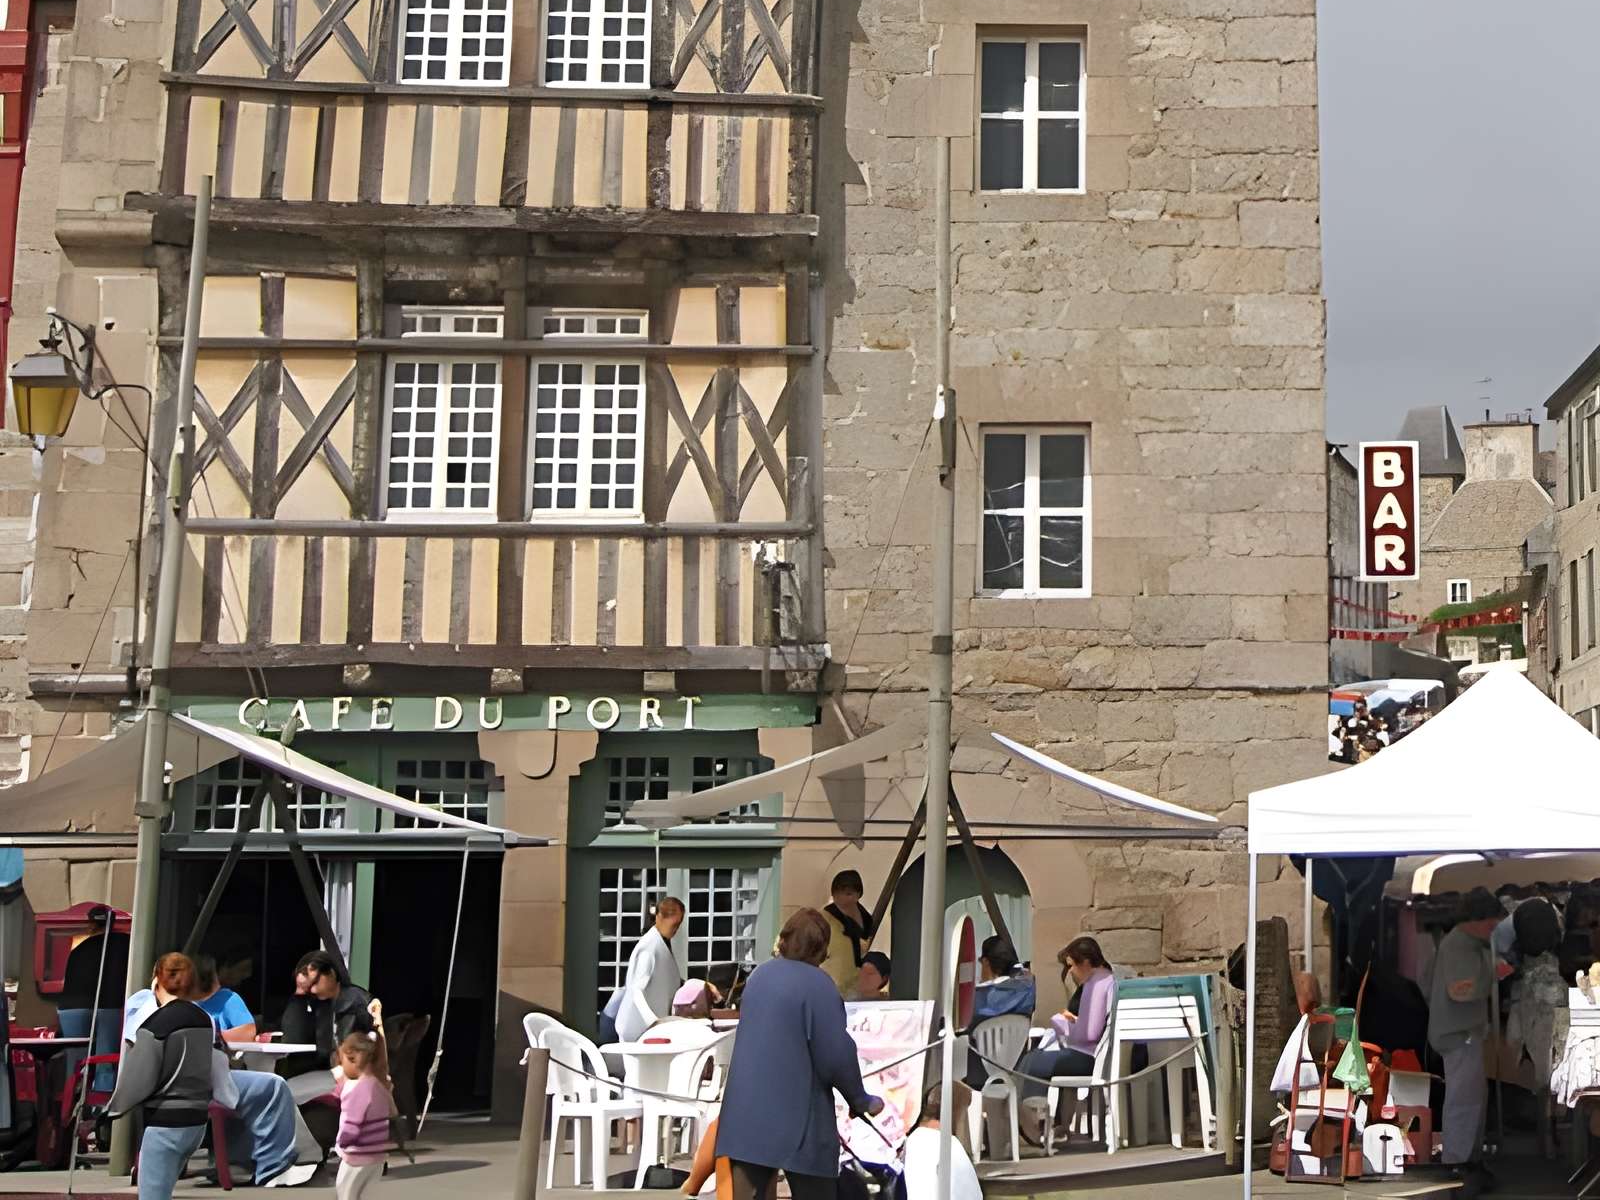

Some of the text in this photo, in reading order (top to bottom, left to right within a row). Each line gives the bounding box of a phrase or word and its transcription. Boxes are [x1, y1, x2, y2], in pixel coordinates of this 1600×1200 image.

[1373, 451, 1407, 571] BAR
[435, 696, 503, 730] DU
[547, 696, 701, 730] PORT
